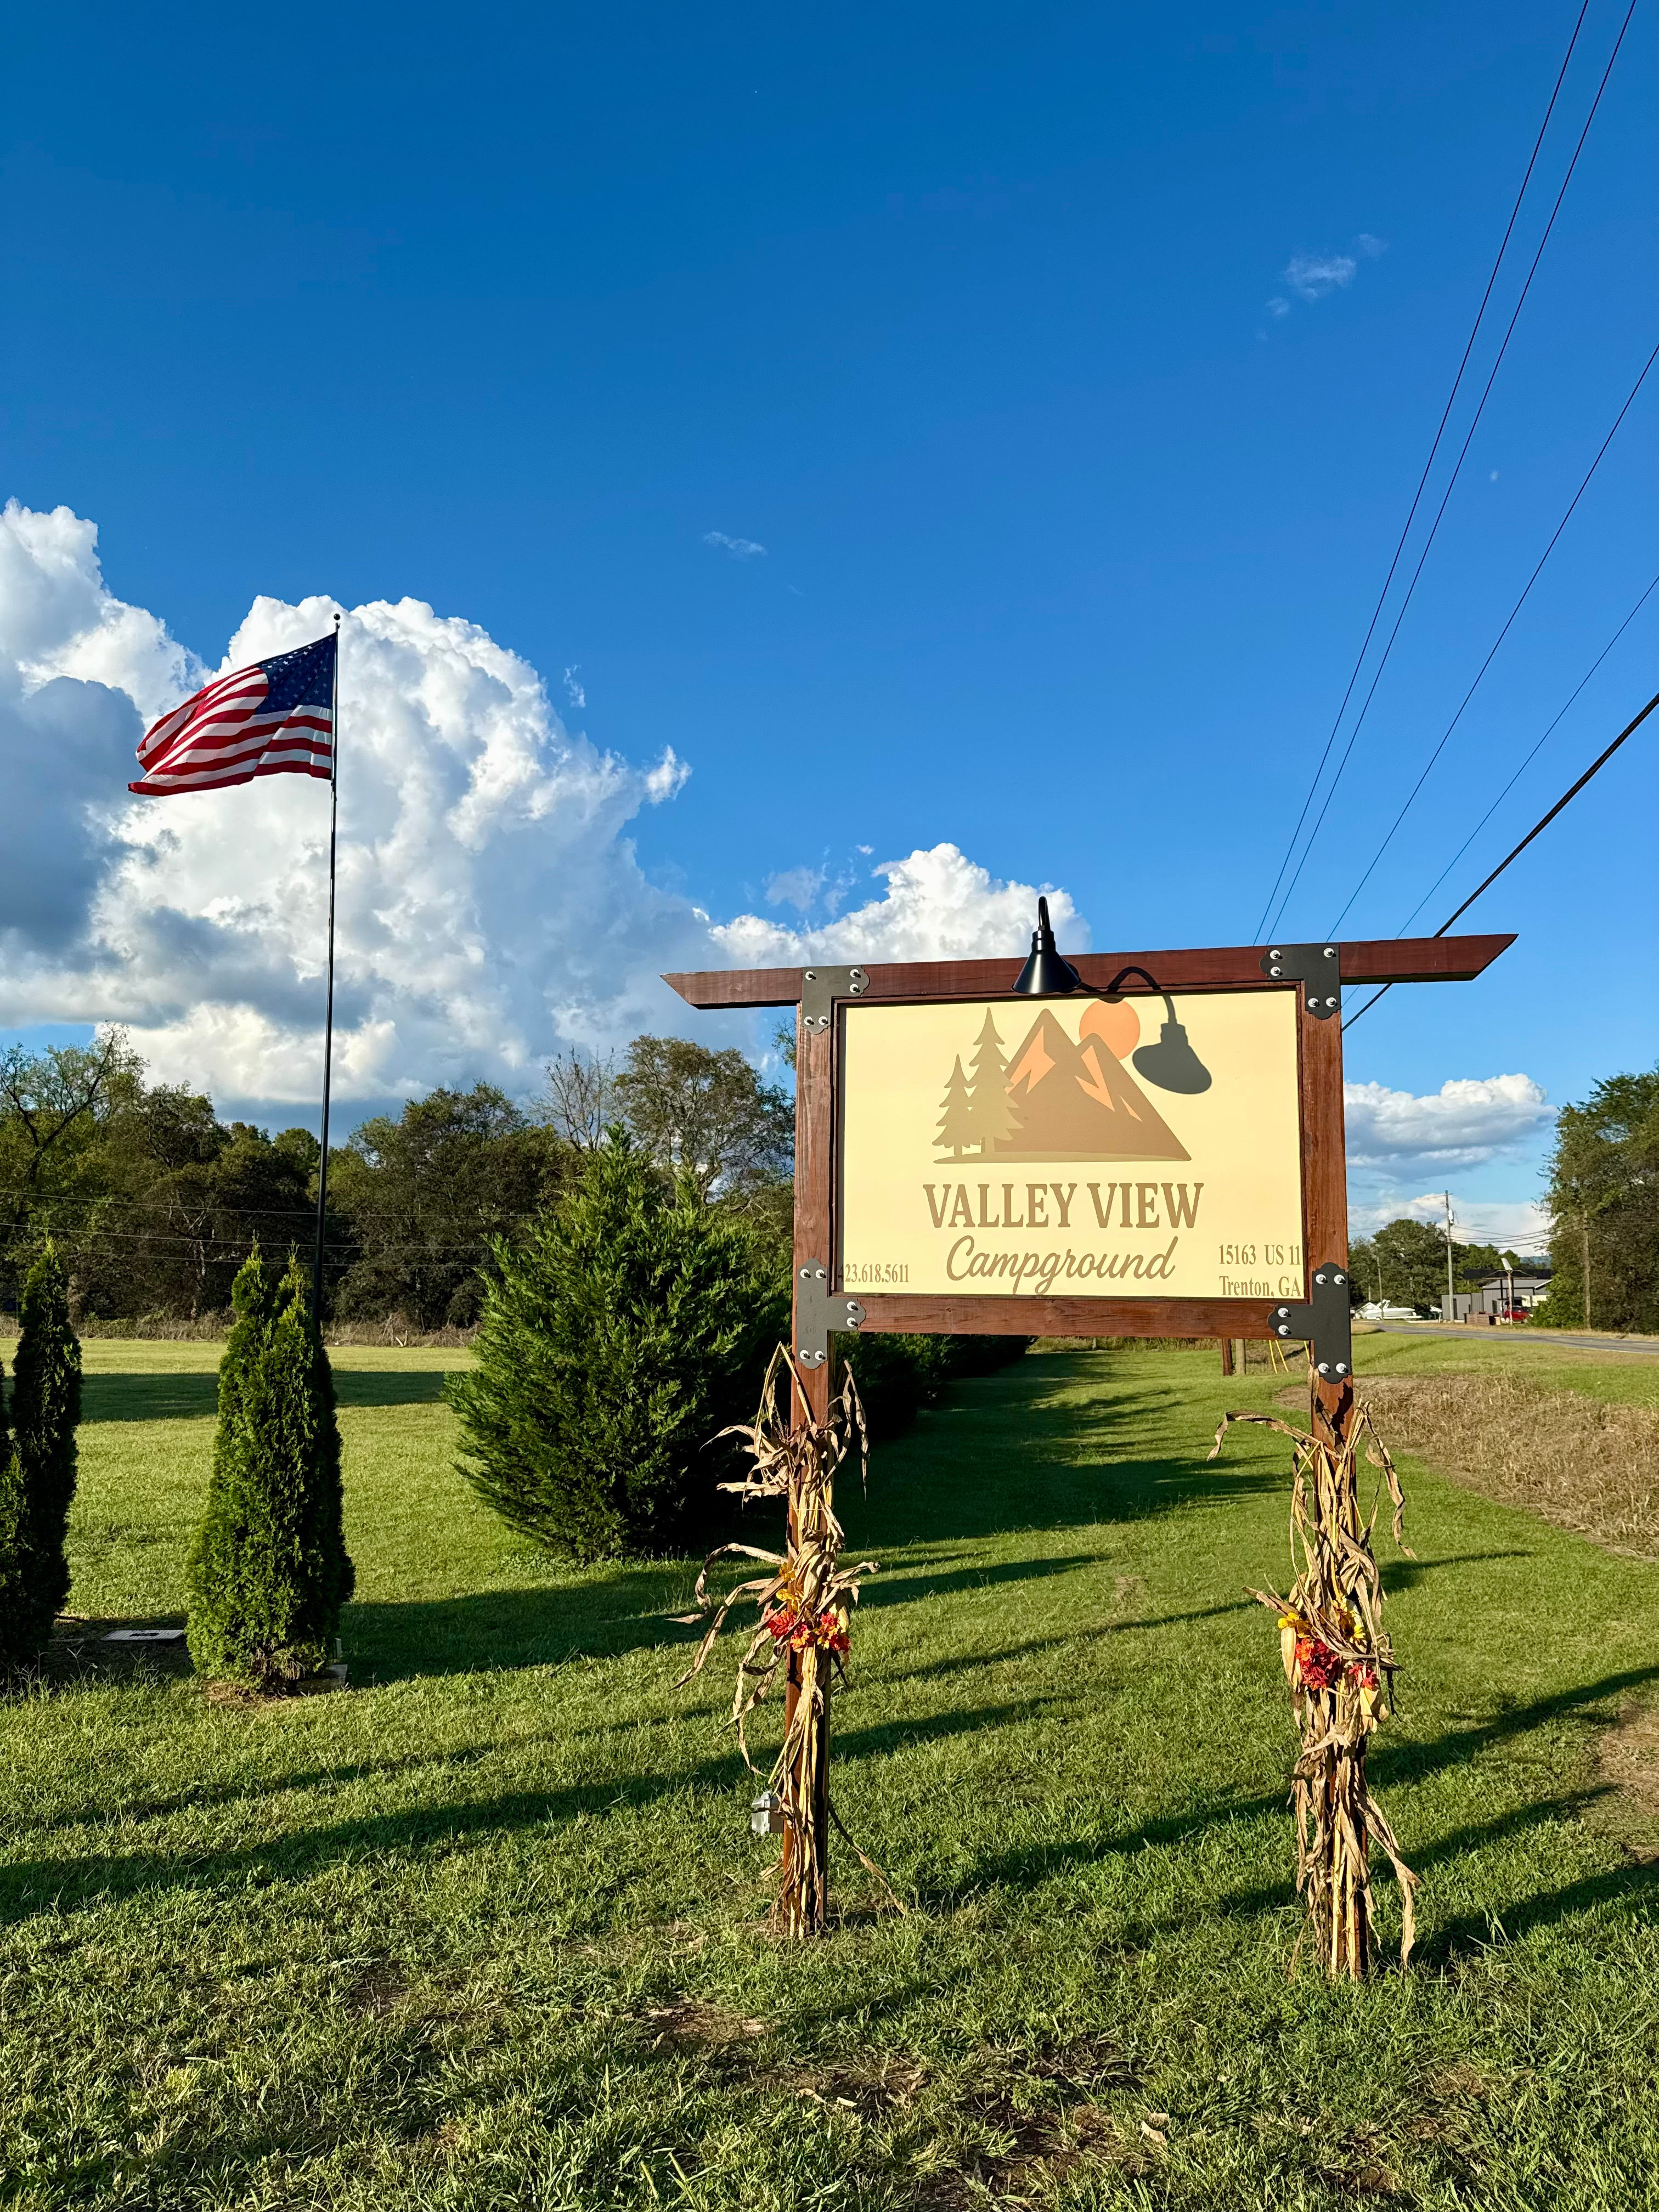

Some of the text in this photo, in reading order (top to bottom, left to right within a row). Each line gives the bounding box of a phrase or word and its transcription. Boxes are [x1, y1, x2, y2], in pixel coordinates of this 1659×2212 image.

[922, 1182, 1204, 1228] VALLEY VIEW
[946, 1235, 1178, 1295] Campground
[1219, 1244, 1301, 1265] 15163 US 11
[1219, 1276, 1301, 1298] Trenton, GA
